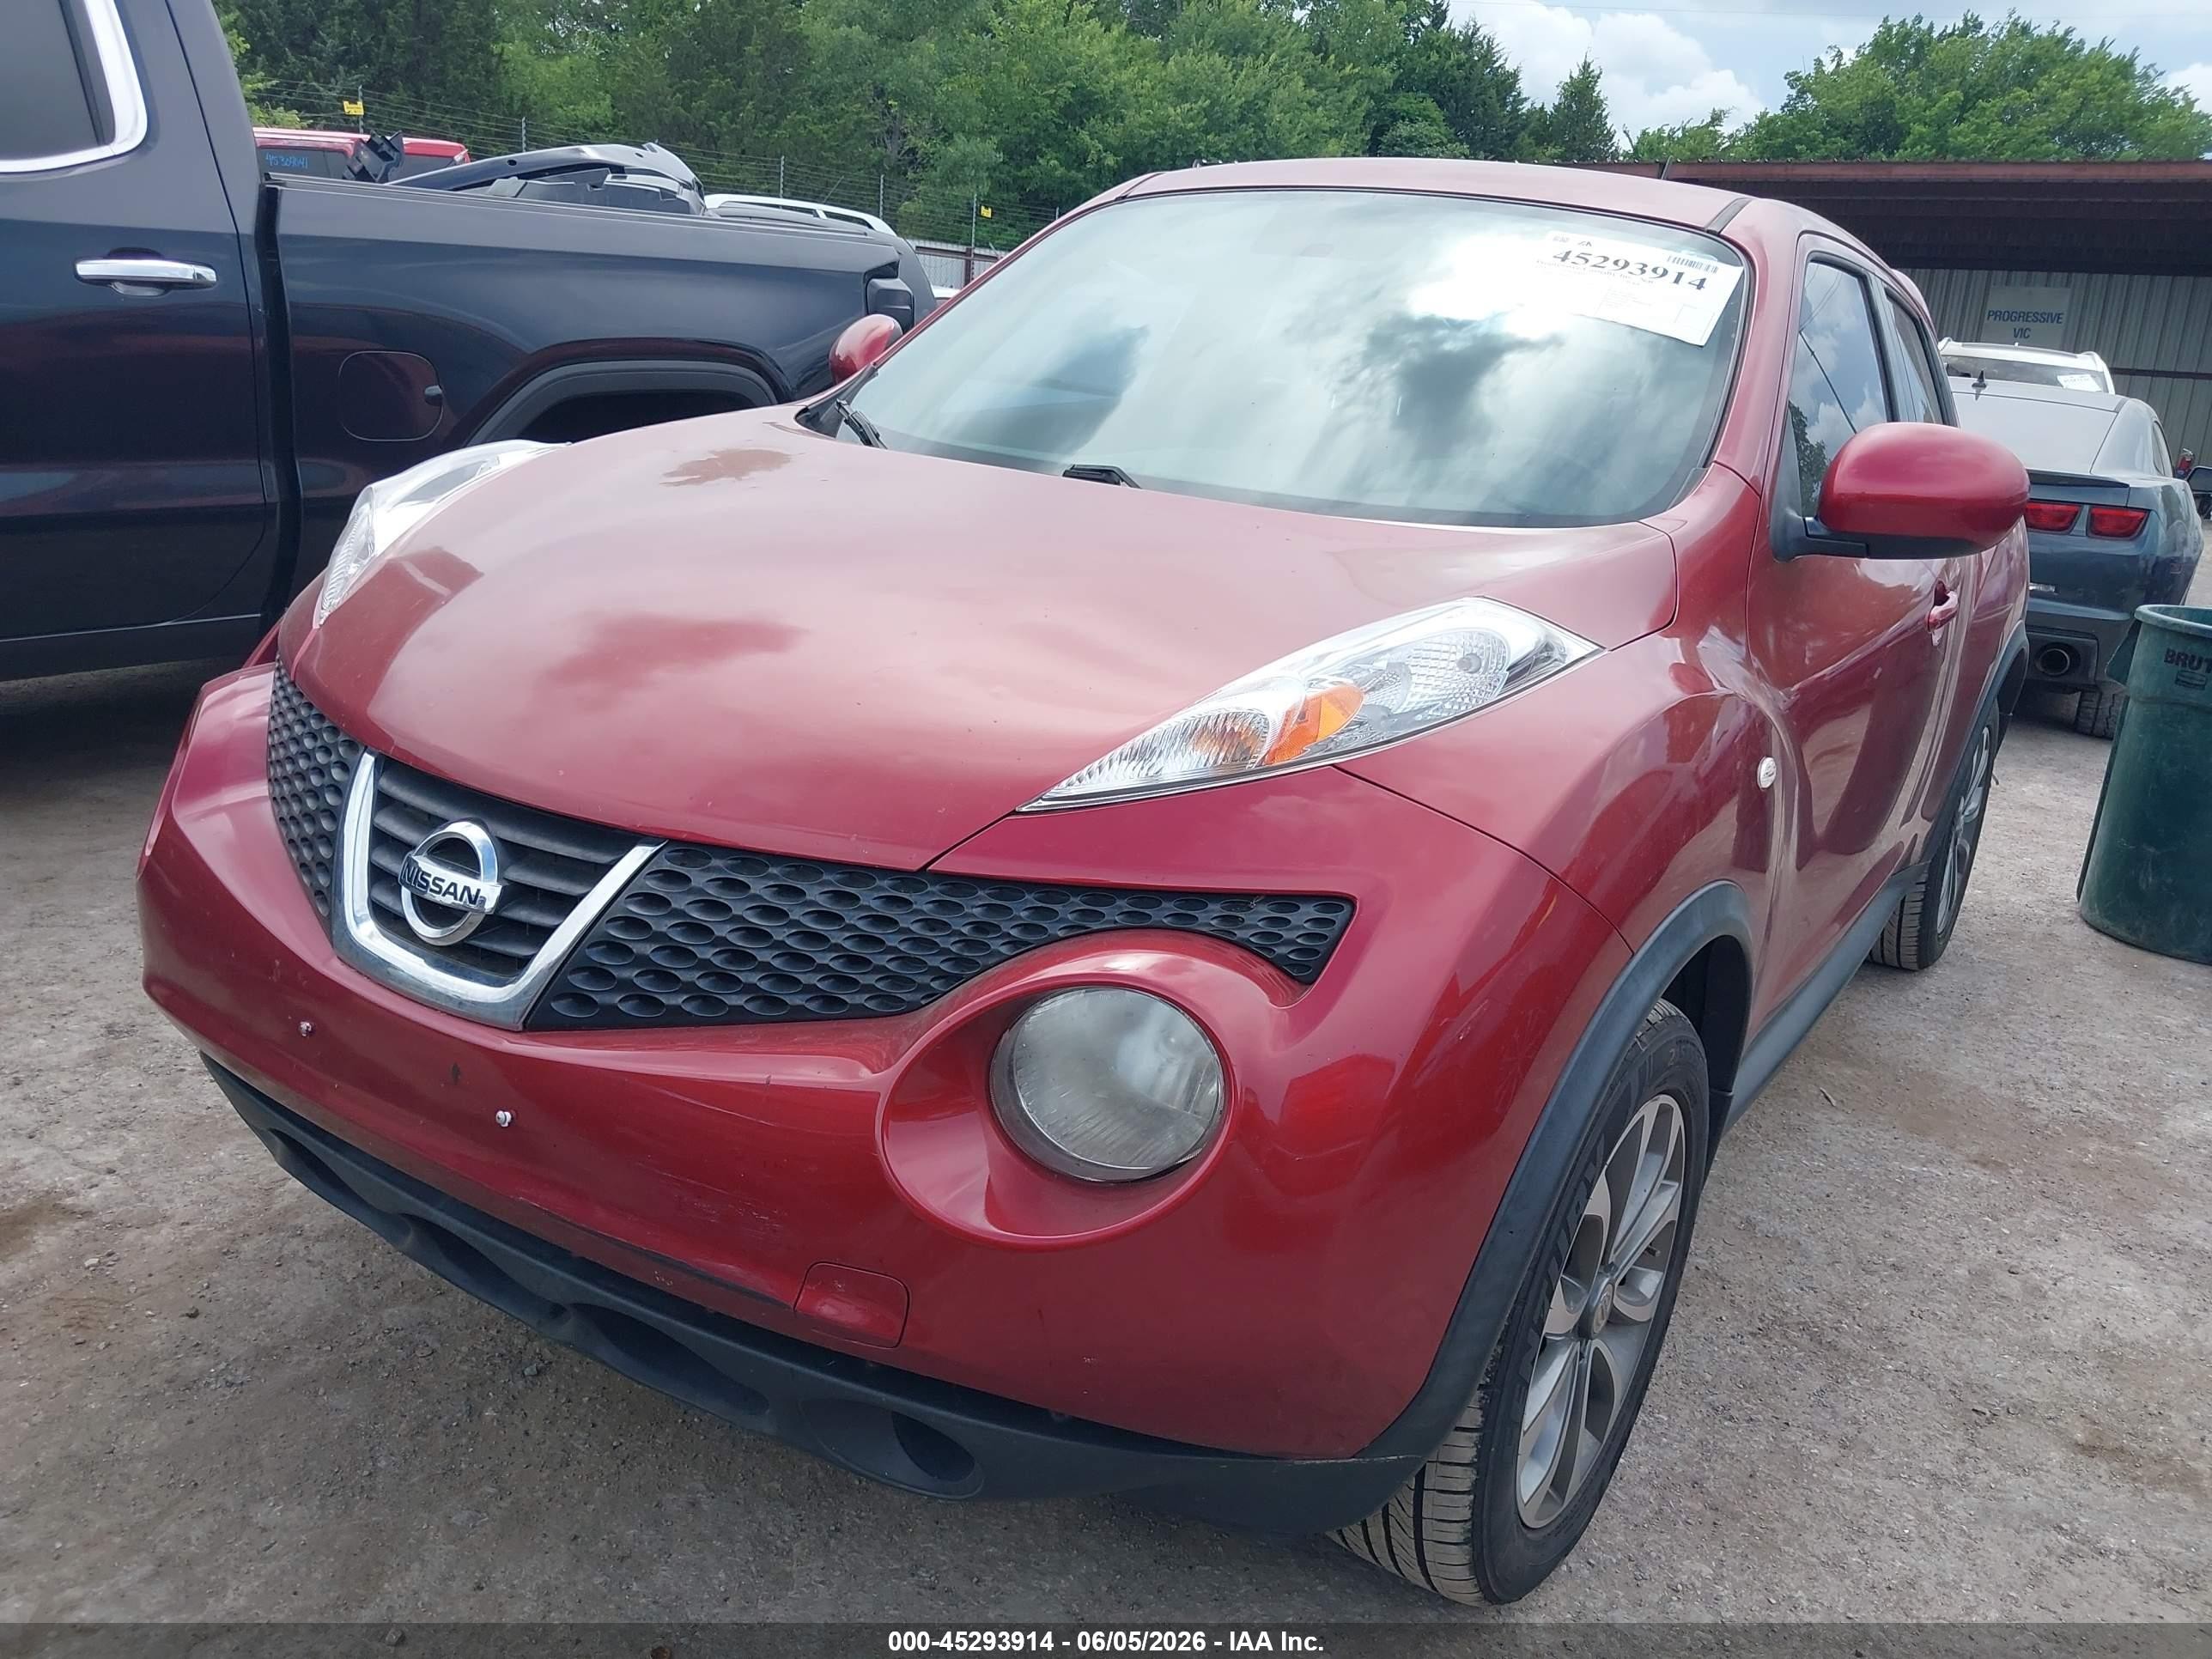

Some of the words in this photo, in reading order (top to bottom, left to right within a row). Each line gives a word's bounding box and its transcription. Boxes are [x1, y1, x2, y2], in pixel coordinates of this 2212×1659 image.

[1553, 250, 1708, 290] 45293914
[1986, 309, 2064, 325] PROGRESSIVE
[2013, 327, 2032, 339] VIC
[400, 859, 482, 906] NISSAN
